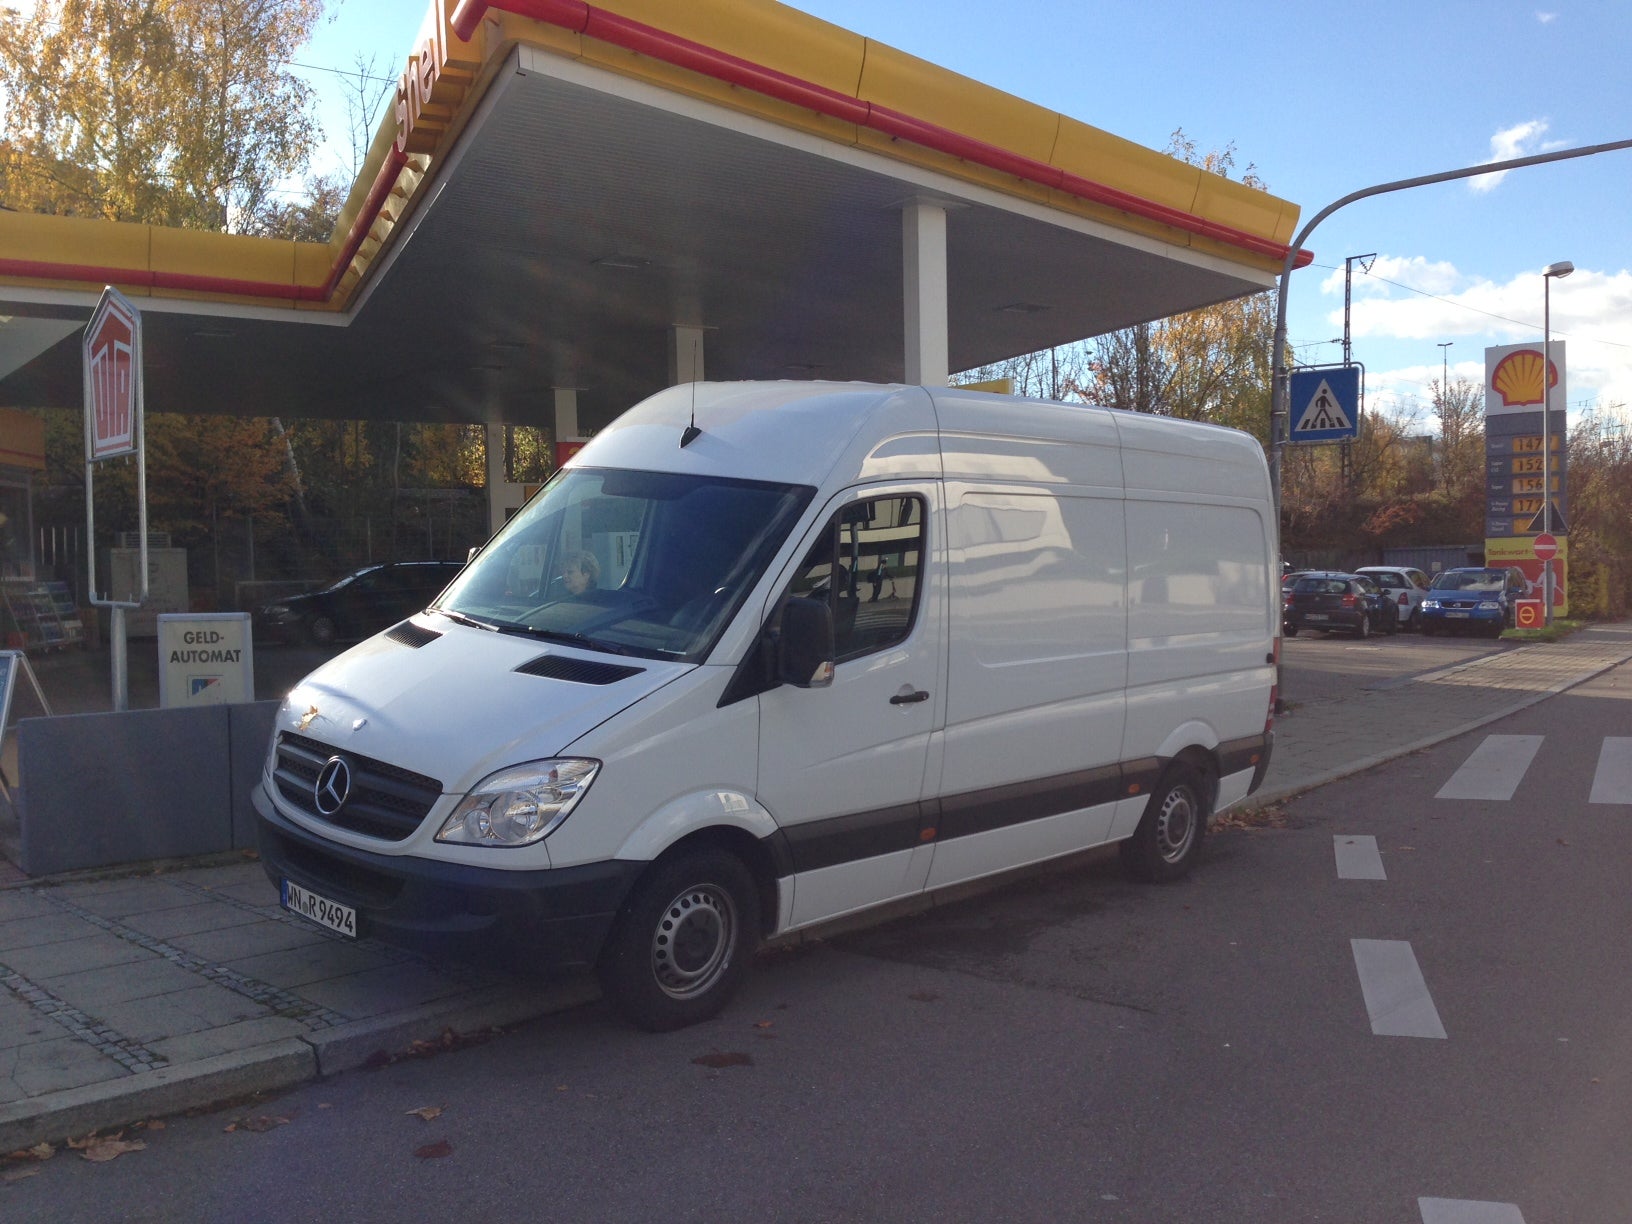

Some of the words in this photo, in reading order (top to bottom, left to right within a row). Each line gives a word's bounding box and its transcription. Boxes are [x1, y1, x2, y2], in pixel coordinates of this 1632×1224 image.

[395, 0, 448, 152] Shell
[183, 631, 225, 645] GELD-
[170, 649, 242, 664] AUTOMAT
[308, 894, 317, 918] R
[319, 899, 354, 933] 9494
